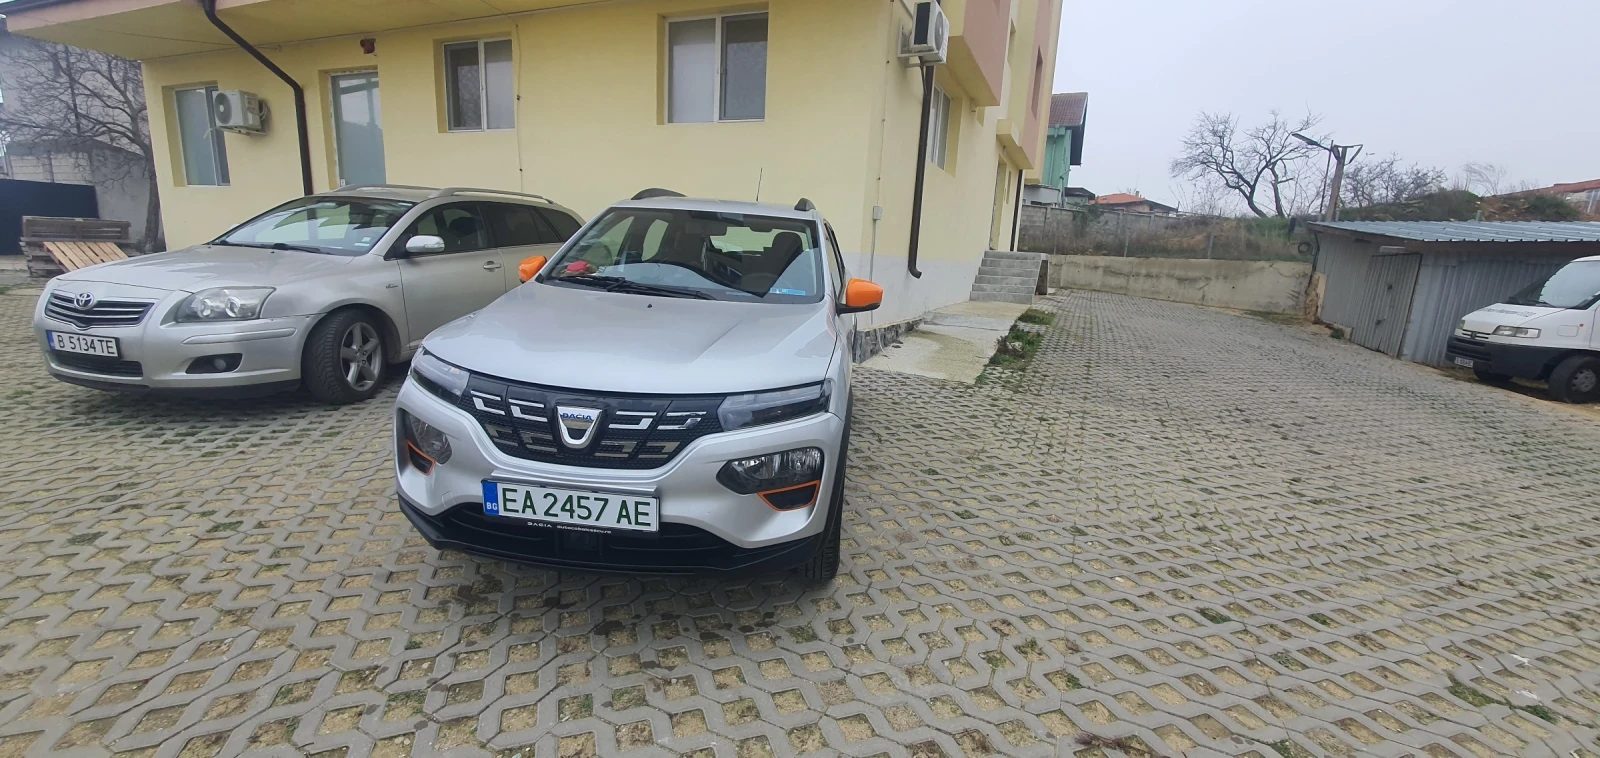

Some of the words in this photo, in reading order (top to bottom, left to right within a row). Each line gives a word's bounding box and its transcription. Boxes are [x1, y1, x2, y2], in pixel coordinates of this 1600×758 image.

[57, 335, 65, 348] B
[69, 336, 96, 352] 5134
[97, 339, 115, 354] TE
[562, 412, 593, 421] DACIA
[486, 502, 498, 511] BG
[502, 488, 537, 515] EA
[543, 492, 609, 521] 2457
[616, 500, 651, 527] AE
